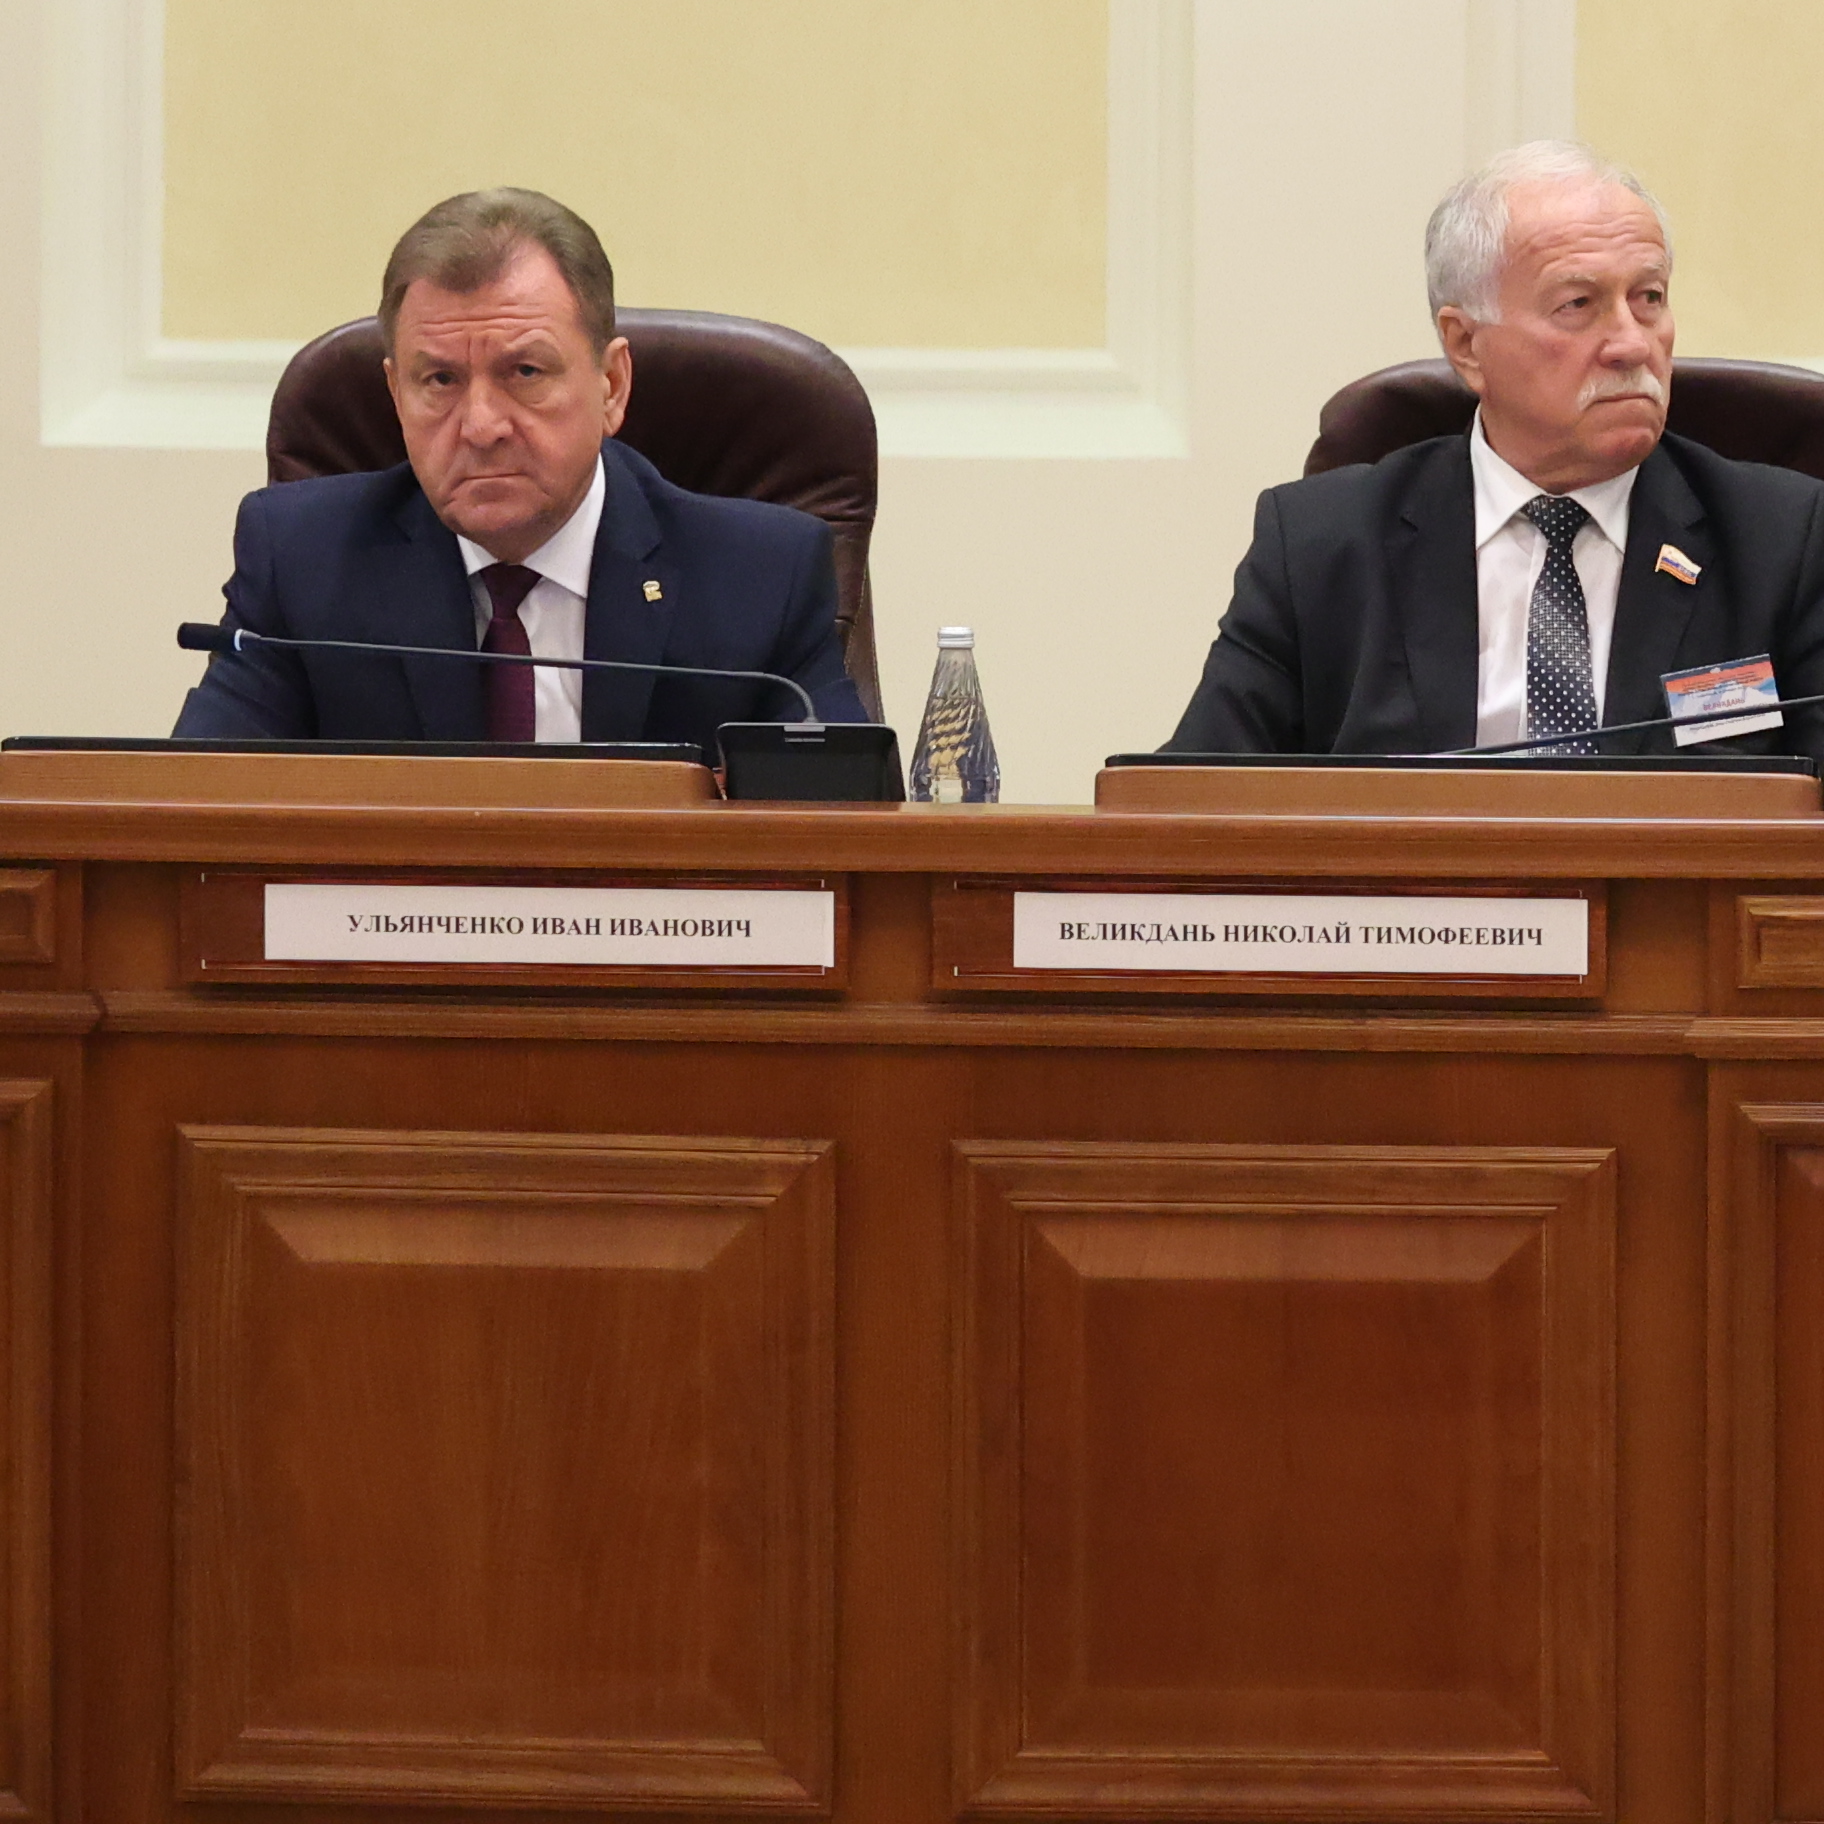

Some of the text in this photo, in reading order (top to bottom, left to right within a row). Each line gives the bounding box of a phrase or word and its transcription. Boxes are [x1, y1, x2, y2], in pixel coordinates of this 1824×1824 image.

[347, 915, 750, 937] УЛЬЯНЧЕНКО ИВАН ИВАНОВИЧ
[1060, 922, 1542, 945] ВЕЛИКДАНЬ НИКОЛАЙ ТИМОФЕЕВИЧ
